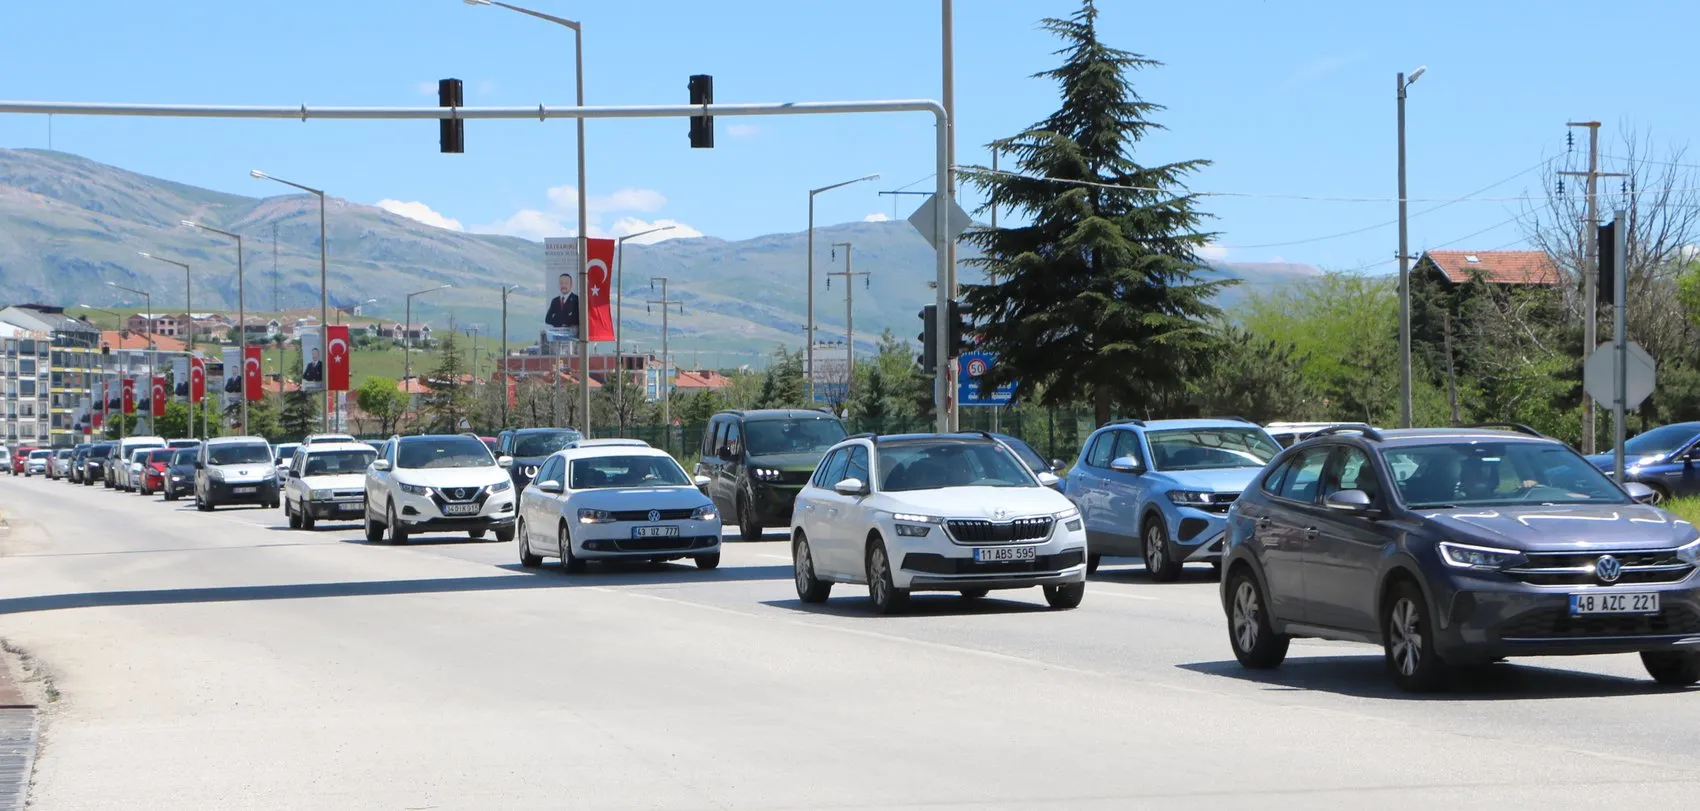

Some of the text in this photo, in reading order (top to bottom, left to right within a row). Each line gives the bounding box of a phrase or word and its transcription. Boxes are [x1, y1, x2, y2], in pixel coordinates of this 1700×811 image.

[971, 364, 982, 374] 50
[651, 527, 659, 536] UZ
[665, 527, 677, 536] 777
[981, 548, 1034, 560] 11 ABS 595
[1578, 594, 1656, 611] 48 AZC 221
